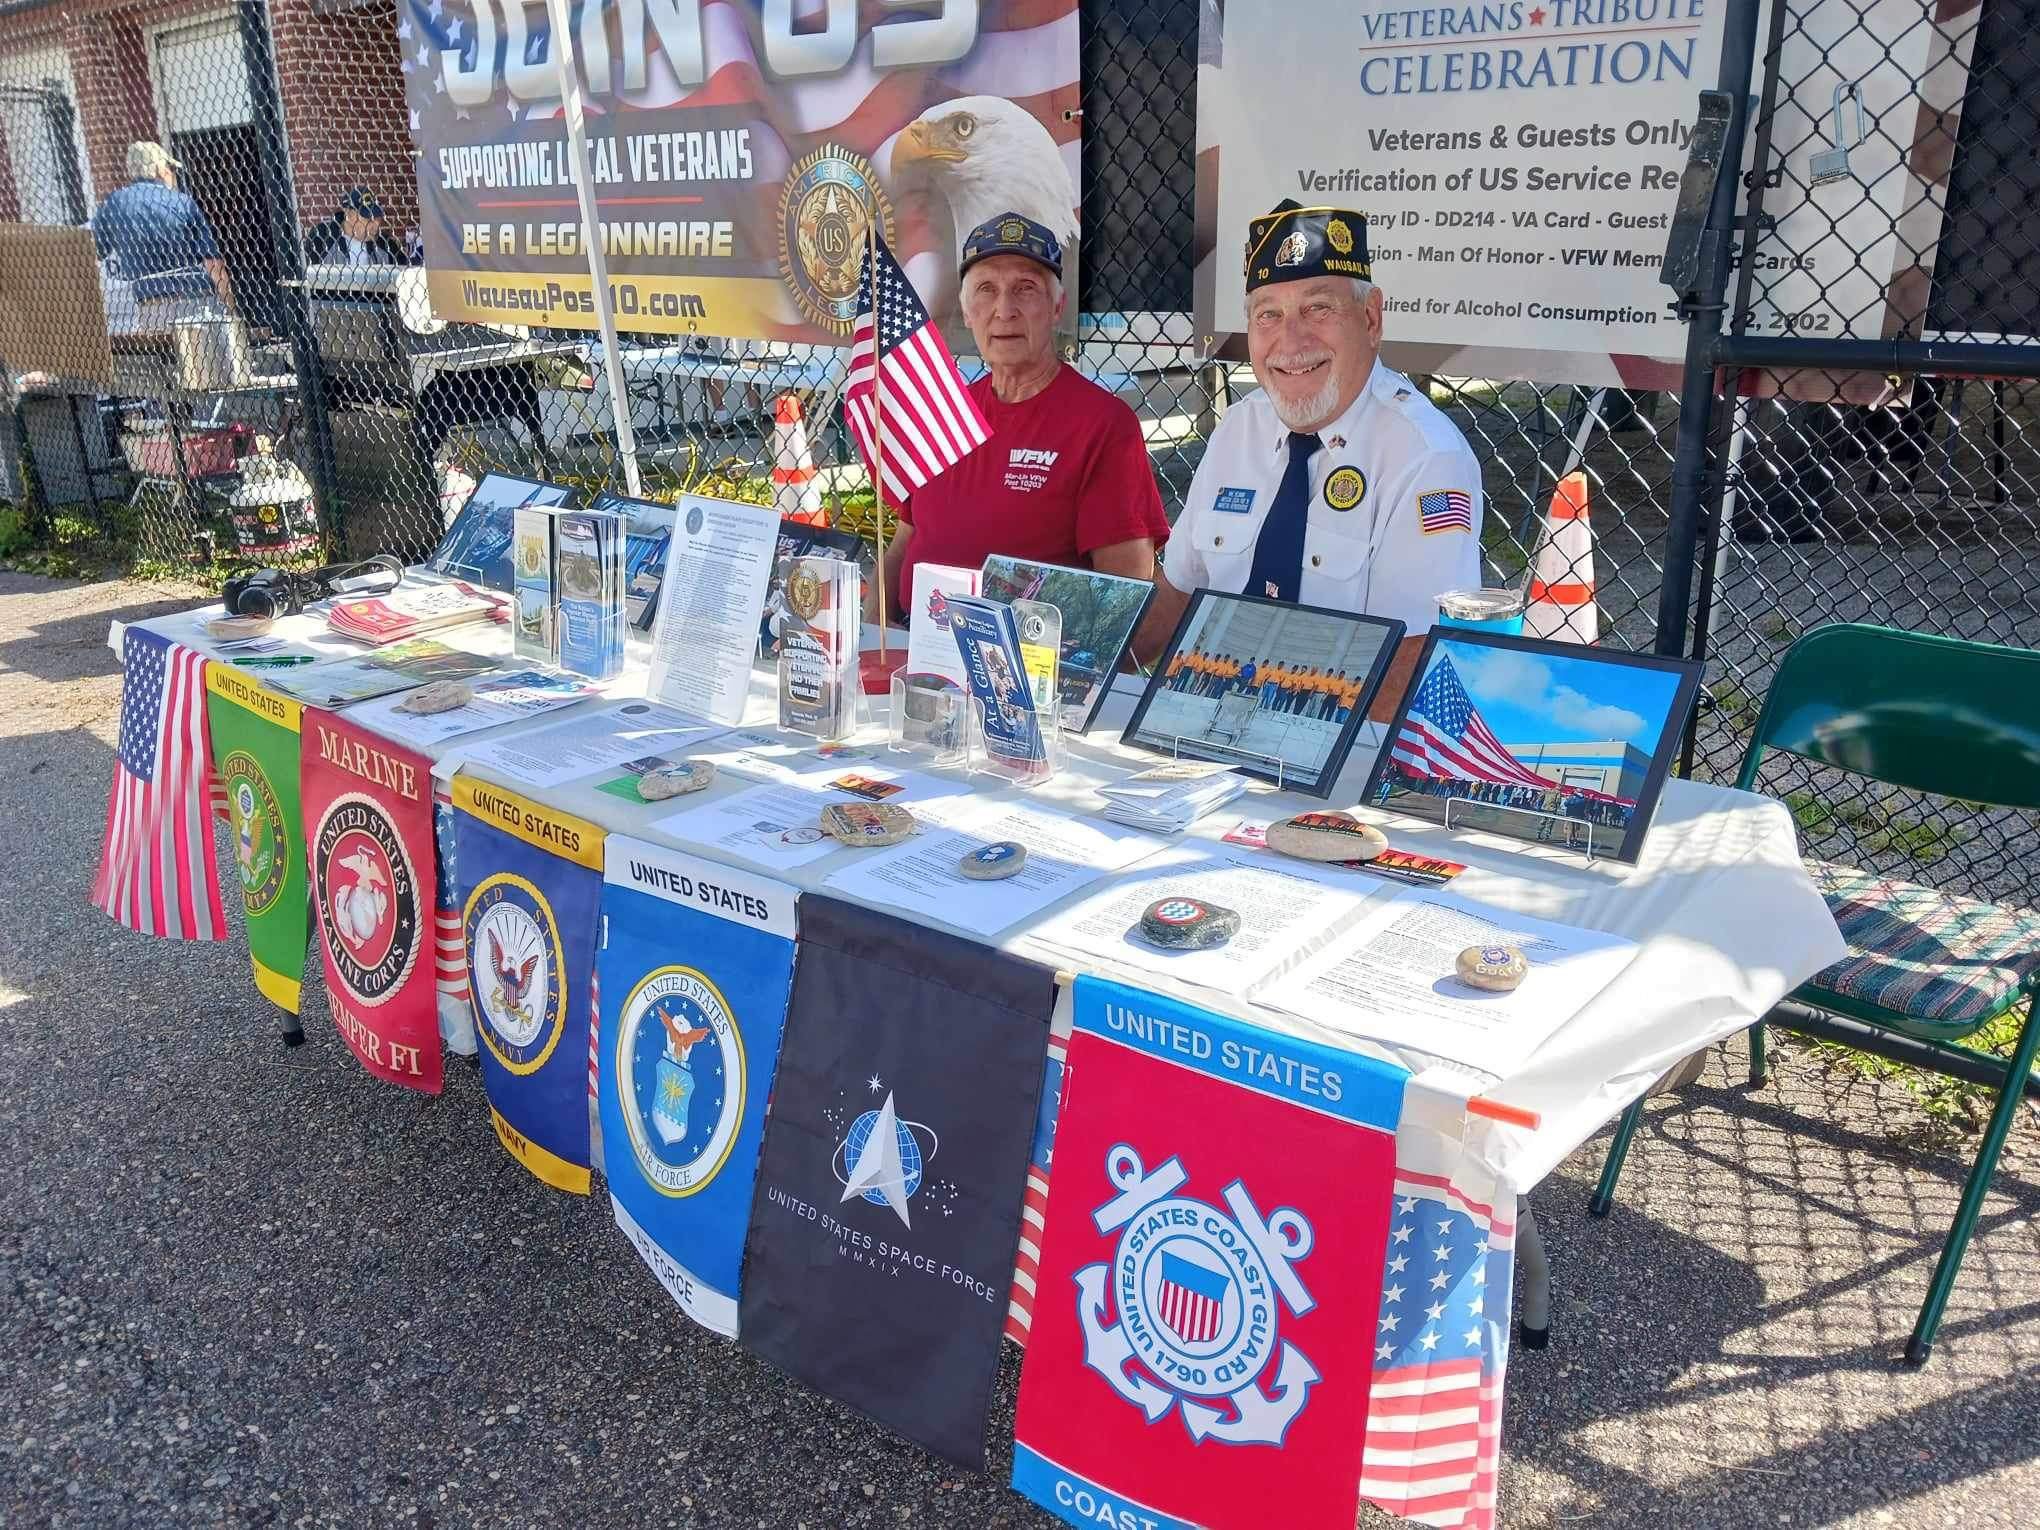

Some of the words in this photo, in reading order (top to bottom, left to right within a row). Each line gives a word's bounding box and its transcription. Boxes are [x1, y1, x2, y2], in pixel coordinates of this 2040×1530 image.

[1362, 1, 1524, 41] VETERANS
[1553, 0, 1705, 28] TRIBUTE
[1360, 38, 1698, 96] CELEBRATION
[1368, 128, 1482, 152] Veterans
[1489, 124, 1508, 149] &
[1517, 122, 1617, 149] Guests
[1625, 119, 1696, 151] Only
[439, 141, 552, 190] SUPPORTING
[626, 129, 754, 182] VETERANS
[1298, 168, 1437, 192] Verification
[1445, 168, 1474, 191] of
[1479, 167, 1519, 192] US
[1526, 165, 1632, 191] Service
[462, 224, 490, 255] BE
[499, 224, 516, 254] A
[1402, 211, 1420, 227] ID
[1435, 211, 1495, 228] DD214
[1512, 211, 1538, 228] VA
[1544, 211, 1590, 229] Card
[1607, 211, 1668, 230] Guest
[1257, 267, 1269, 280] 10
[1418, 246, 1455, 263] Man
[1460, 247, 1483, 263] Of
[1487, 247, 1545, 265] Honor
[1561, 249, 1608, 266] VFW
[462, 279, 707, 319] WausauPos10.com
[1426, 296, 1450, 313] for
[1455, 299, 1523, 318] Alcohol
[1527, 302, 1657, 325] Consumption
[1768, 312, 1830, 332] 2002
[1010, 448, 1059, 466] VFW
[215, 672, 249, 701] UNITED
[249, 691, 286, 719] STATES
[316, 724, 420, 801] MARINE
[473, 787, 521, 827] UNITED
[525, 812, 580, 853] STATES
[320, 808, 367, 856] UNITED
[369, 813, 409, 896] STATES
[630, 860, 694, 897] UNITED
[698, 881, 769, 921] STATES
[320, 900, 362, 991] MARINE
[363, 942, 406, 993] CORPS
[533, 908, 560, 1024] STATES
[643, 976, 689, 1002] UNITED
[691, 982, 728, 1036] STATES
[388, 1041, 423, 1076] FI
[489, 1029, 525, 1064] NAVY
[1105, 1002, 1212, 1060] UNITED
[1221, 1040, 1344, 1102] STATES
[654, 1163, 692, 1187] FORCE
[768, 1186, 817, 1221] UNITED
[821, 1214, 872, 1249] STATES
[878, 1241, 936, 1274] SPACE
[941, 1265, 996, 1303] FORCE
[1130, 1208, 1199, 1254] STATES
[653, 1249, 694, 1304] FORCE
[1203, 1216, 1267, 1300] COAST
[1122, 1254, 1154, 1353] UNITED
[1155, 1349, 1207, 1386] 1790
[1214, 1304, 1268, 1384] GUARD
